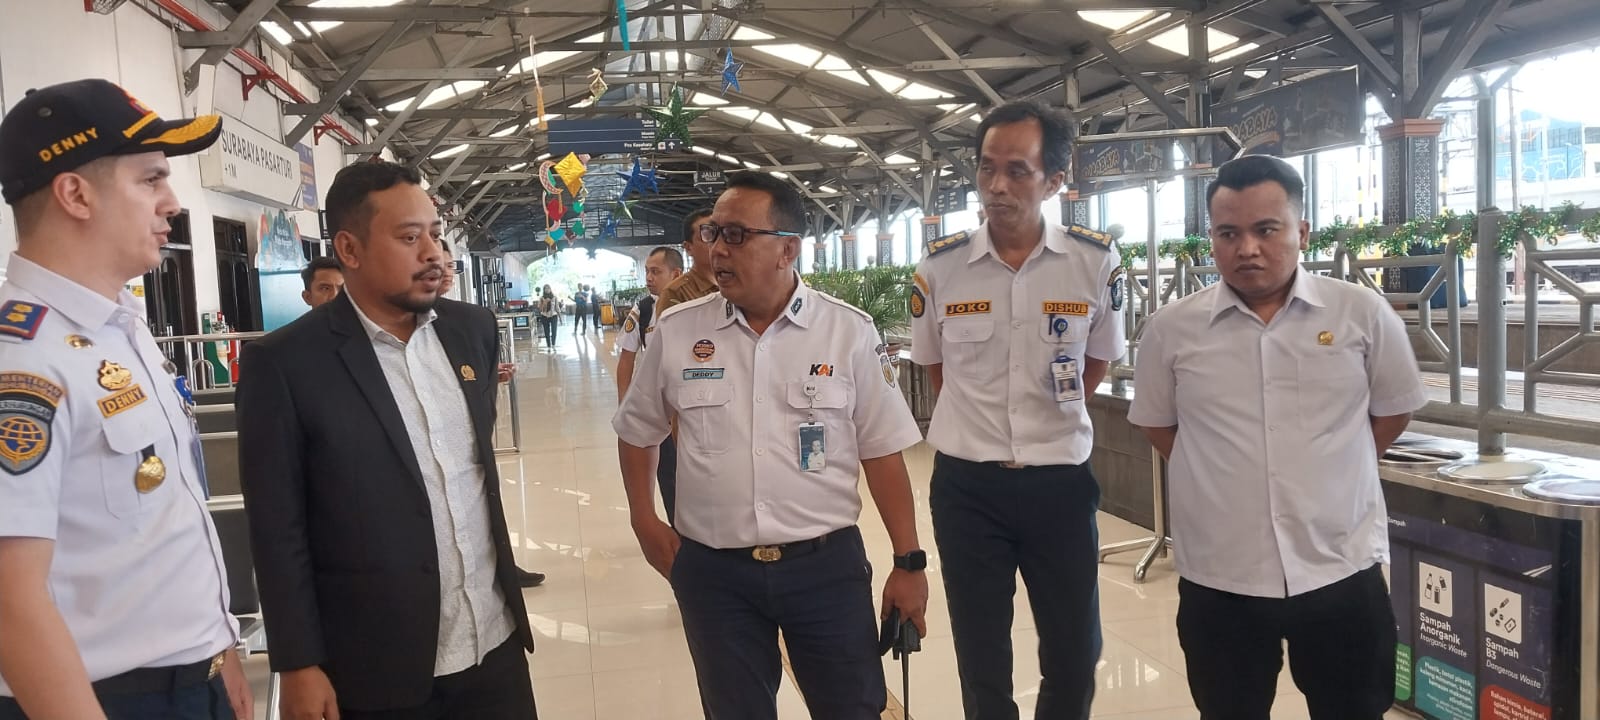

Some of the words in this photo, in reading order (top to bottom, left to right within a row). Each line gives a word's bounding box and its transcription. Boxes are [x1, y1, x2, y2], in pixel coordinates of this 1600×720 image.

[38, 127, 99, 162] DENNY
[221, 129, 260, 167] SURABAYA
[260, 147, 293, 179] PASARTURI
[948, 302, 987, 313] JOKO
[1046, 303, 1087, 313] DISHUB
[104, 387, 142, 414] DENNY
[1420, 612, 1451, 631] Sampah
[1420, 622, 1461, 646] Anorganik
[1448, 644, 1468, 658] Waste
[1486, 637, 1519, 660] Sampah
[1486, 648, 1497, 660] B3
[1486, 660, 1518, 680] Dangerous
[1519, 673, 1542, 689] Waste
